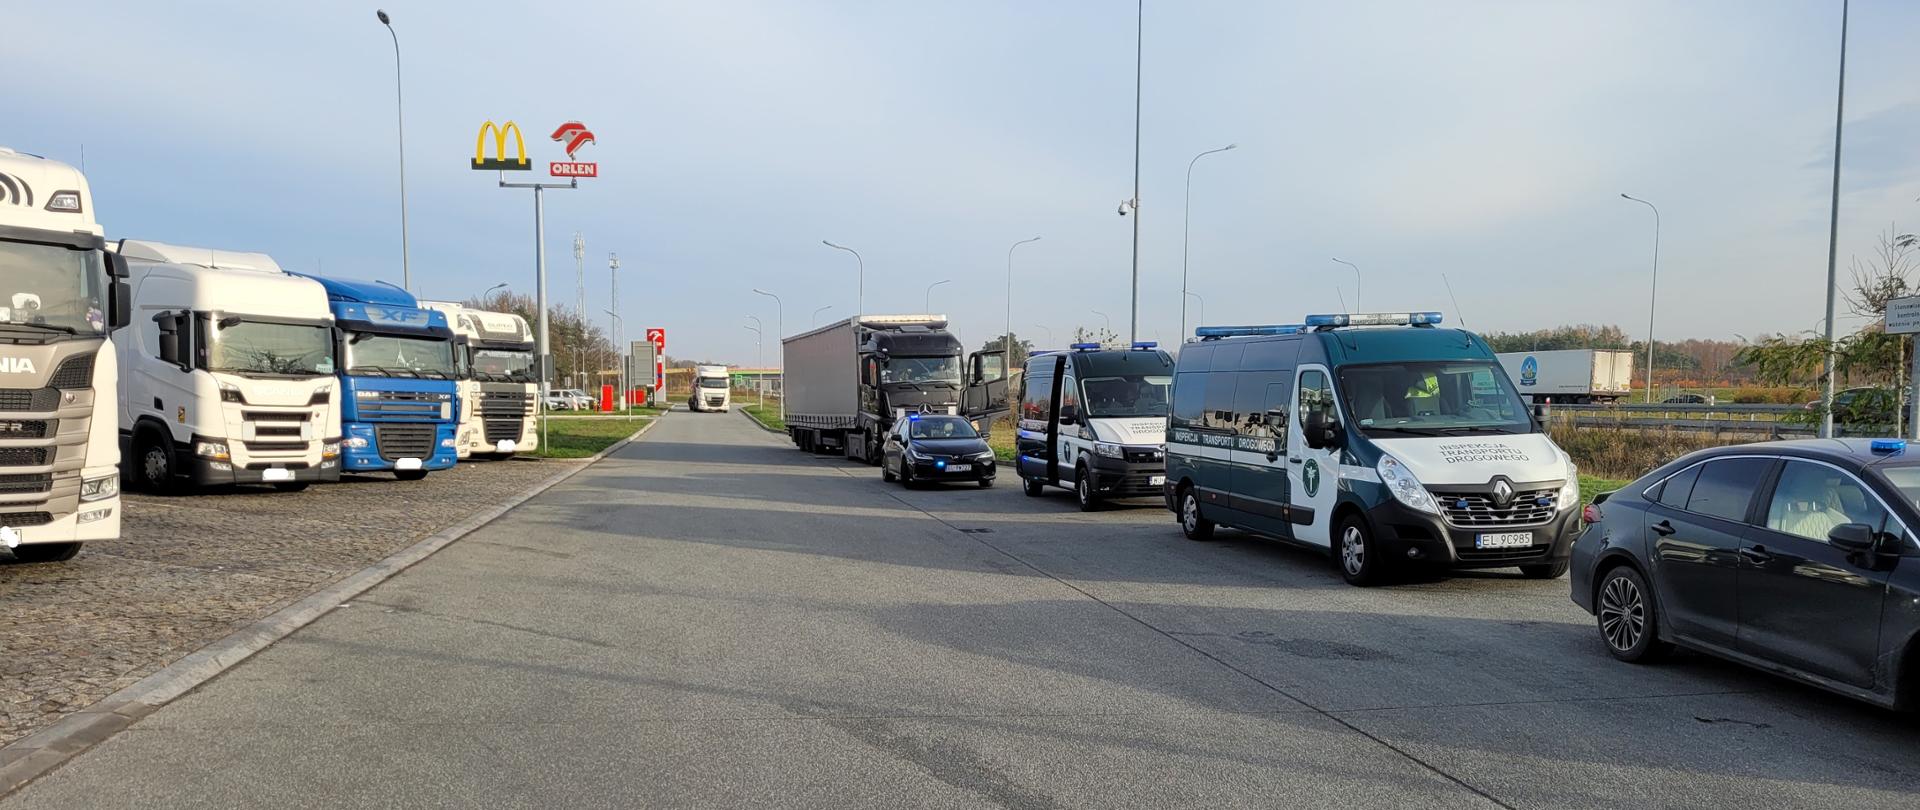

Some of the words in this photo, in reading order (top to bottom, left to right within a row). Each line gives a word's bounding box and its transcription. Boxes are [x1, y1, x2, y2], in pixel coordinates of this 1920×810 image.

[552, 163, 595, 175] ORLEN
[380, 308, 420, 321] XF
[1174, 433, 1199, 443] INSPEKCJA
[1202, 434, 1235, 447] TRANSPORTU
[1238, 437, 1276, 452] DROGOWEGO
[1439, 443, 1508, 451] INSPEKCJA
[1439, 448, 1523, 457] TRANSPORTU
[1445, 454, 1530, 464] DROGOWEGO
[1482, 535, 1497, 546] EL
[1500, 533, 1530, 545] 9C985
